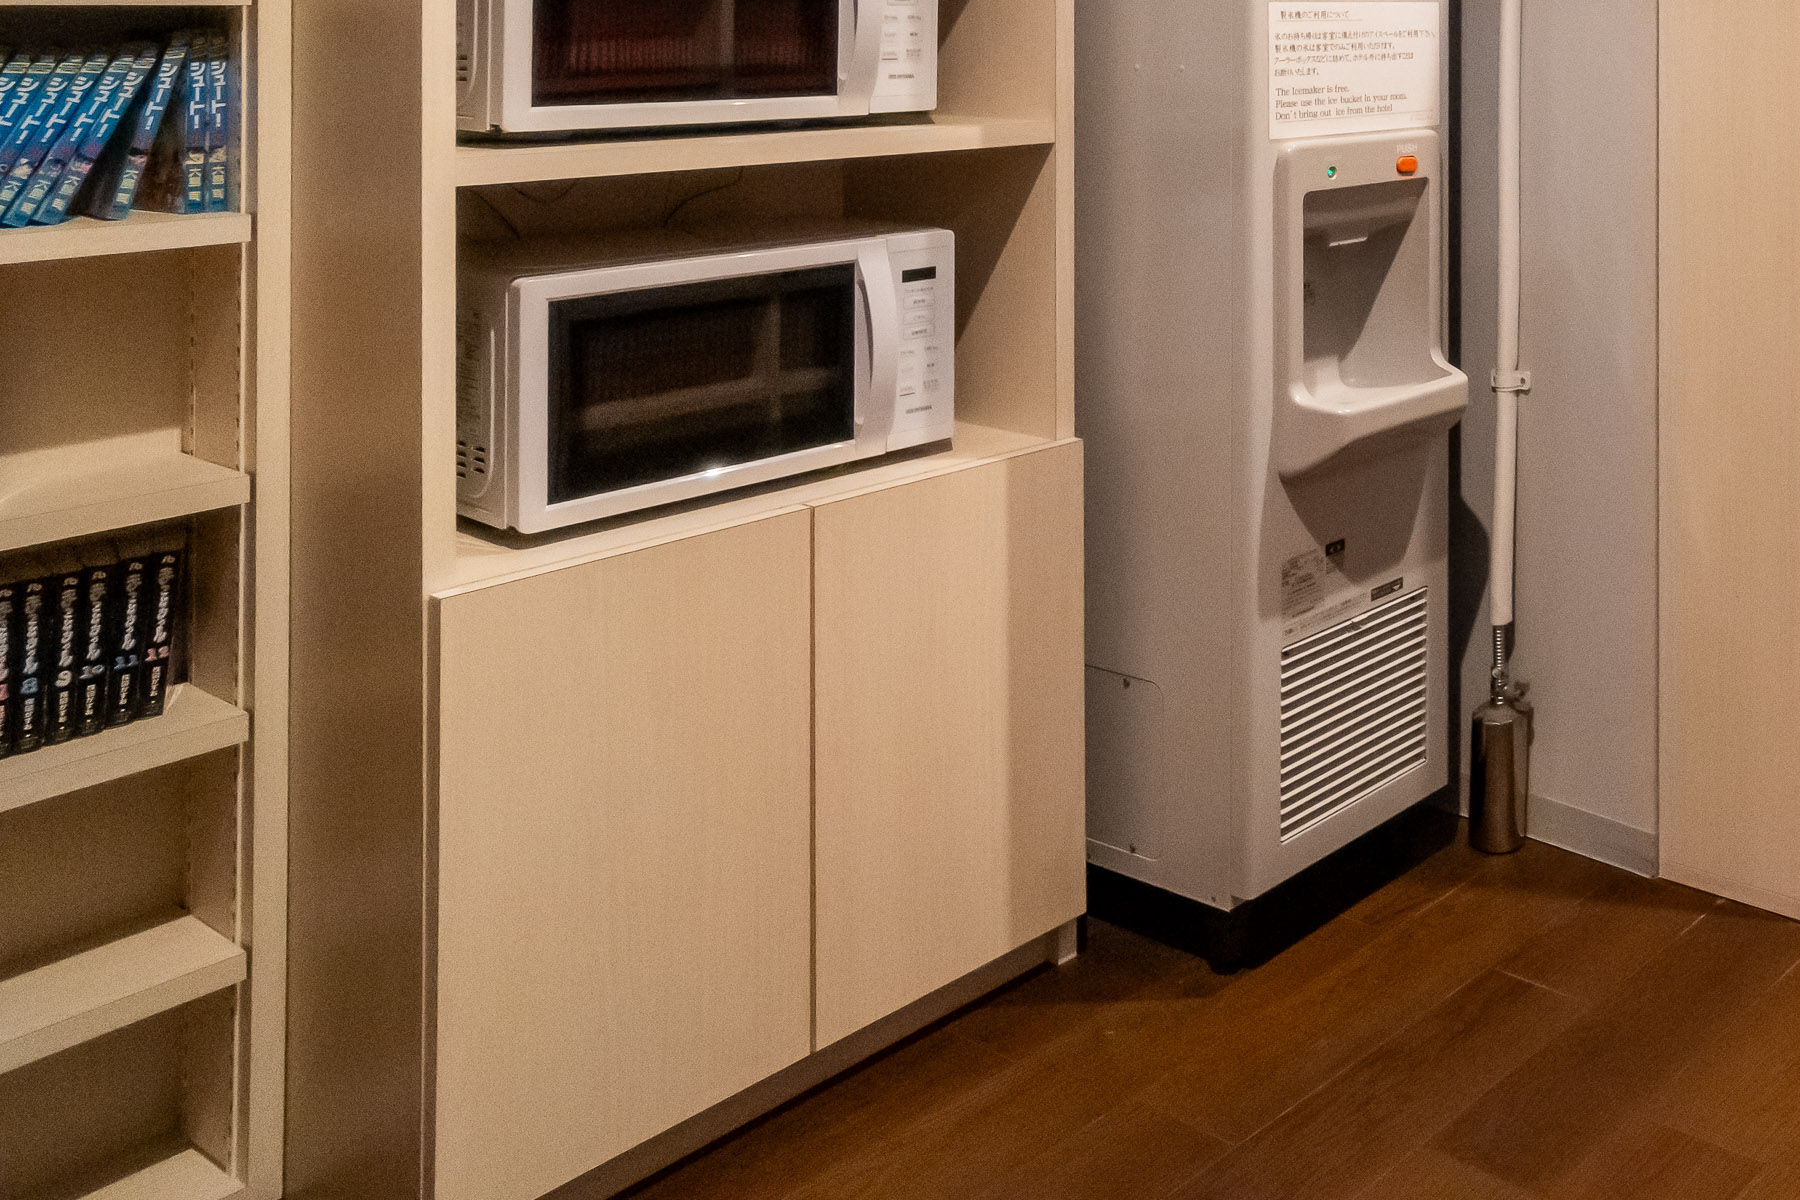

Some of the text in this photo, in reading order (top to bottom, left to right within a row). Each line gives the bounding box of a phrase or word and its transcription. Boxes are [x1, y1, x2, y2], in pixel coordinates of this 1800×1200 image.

[1276, 84, 1350, 96] The Icemaker is free.
[1276, 100, 1298, 108] Please
[1314, 97, 1326, 106] the
[1328, 96, 1338, 105] ice
[1340, 95, 1363, 104] bucket
[1373, 94, 1388, 103] your
[1300, 108, 1318, 120] bring
[1320, 108, 1332, 117] out
[1336, 108, 1346, 116] ice
[1347, 106, 1363, 115] from
[1365, 104, 1375, 114] the
[1376, 104, 1393, 112] hotel
[114, 654, 139, 670] 11
[145, 646, 170, 662] 12
[55, 670, 72, 688] 9
[79, 664, 105, 680] 10
